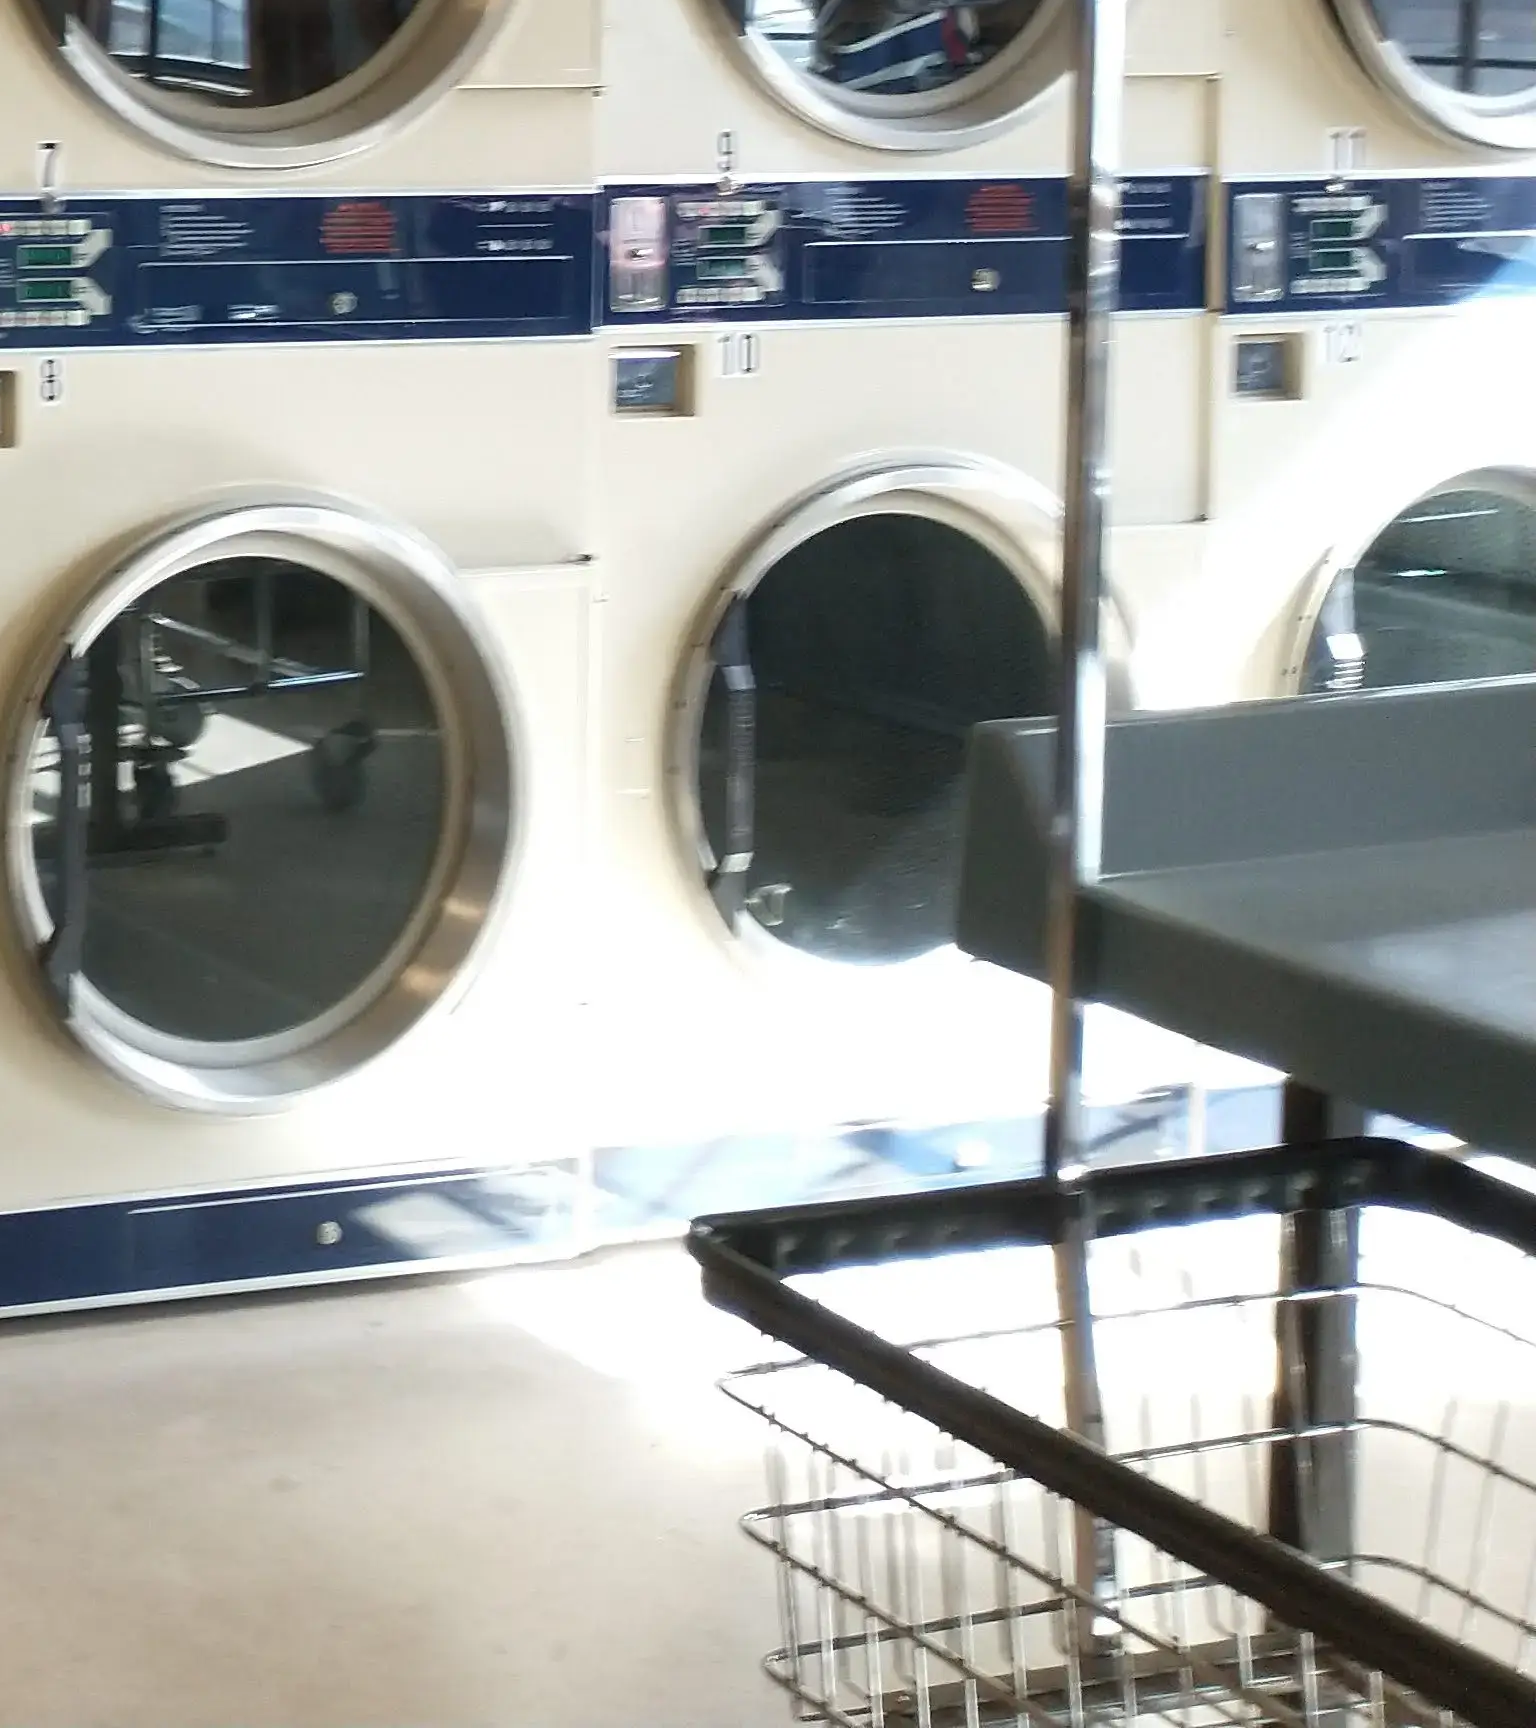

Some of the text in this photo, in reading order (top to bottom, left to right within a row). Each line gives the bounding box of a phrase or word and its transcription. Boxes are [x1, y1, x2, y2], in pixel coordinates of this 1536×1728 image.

[38, 142, 60, 188] 7
[718, 334, 758, 374] 10
[40, 359, 61, 401] 8
